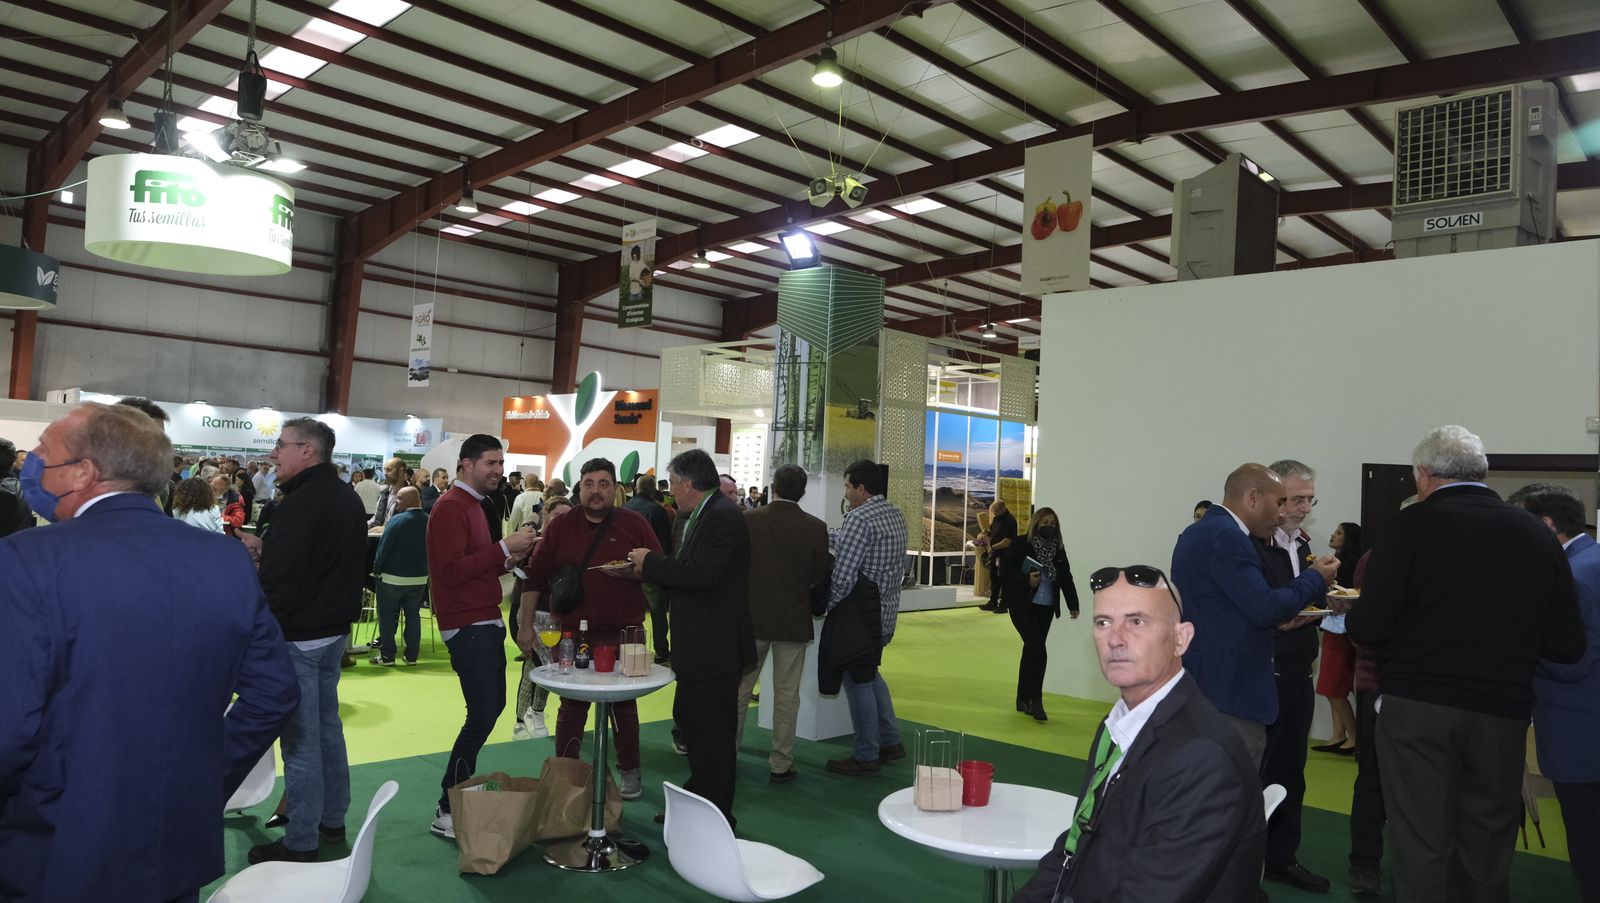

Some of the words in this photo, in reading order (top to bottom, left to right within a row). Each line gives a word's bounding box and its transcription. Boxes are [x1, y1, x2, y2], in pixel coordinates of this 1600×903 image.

[128, 208, 146, 223] Tus
[147, 210, 206, 229] semillas
[1426, 213, 1480, 230] SOLAEN
[202, 416, 253, 430] Ramiro
